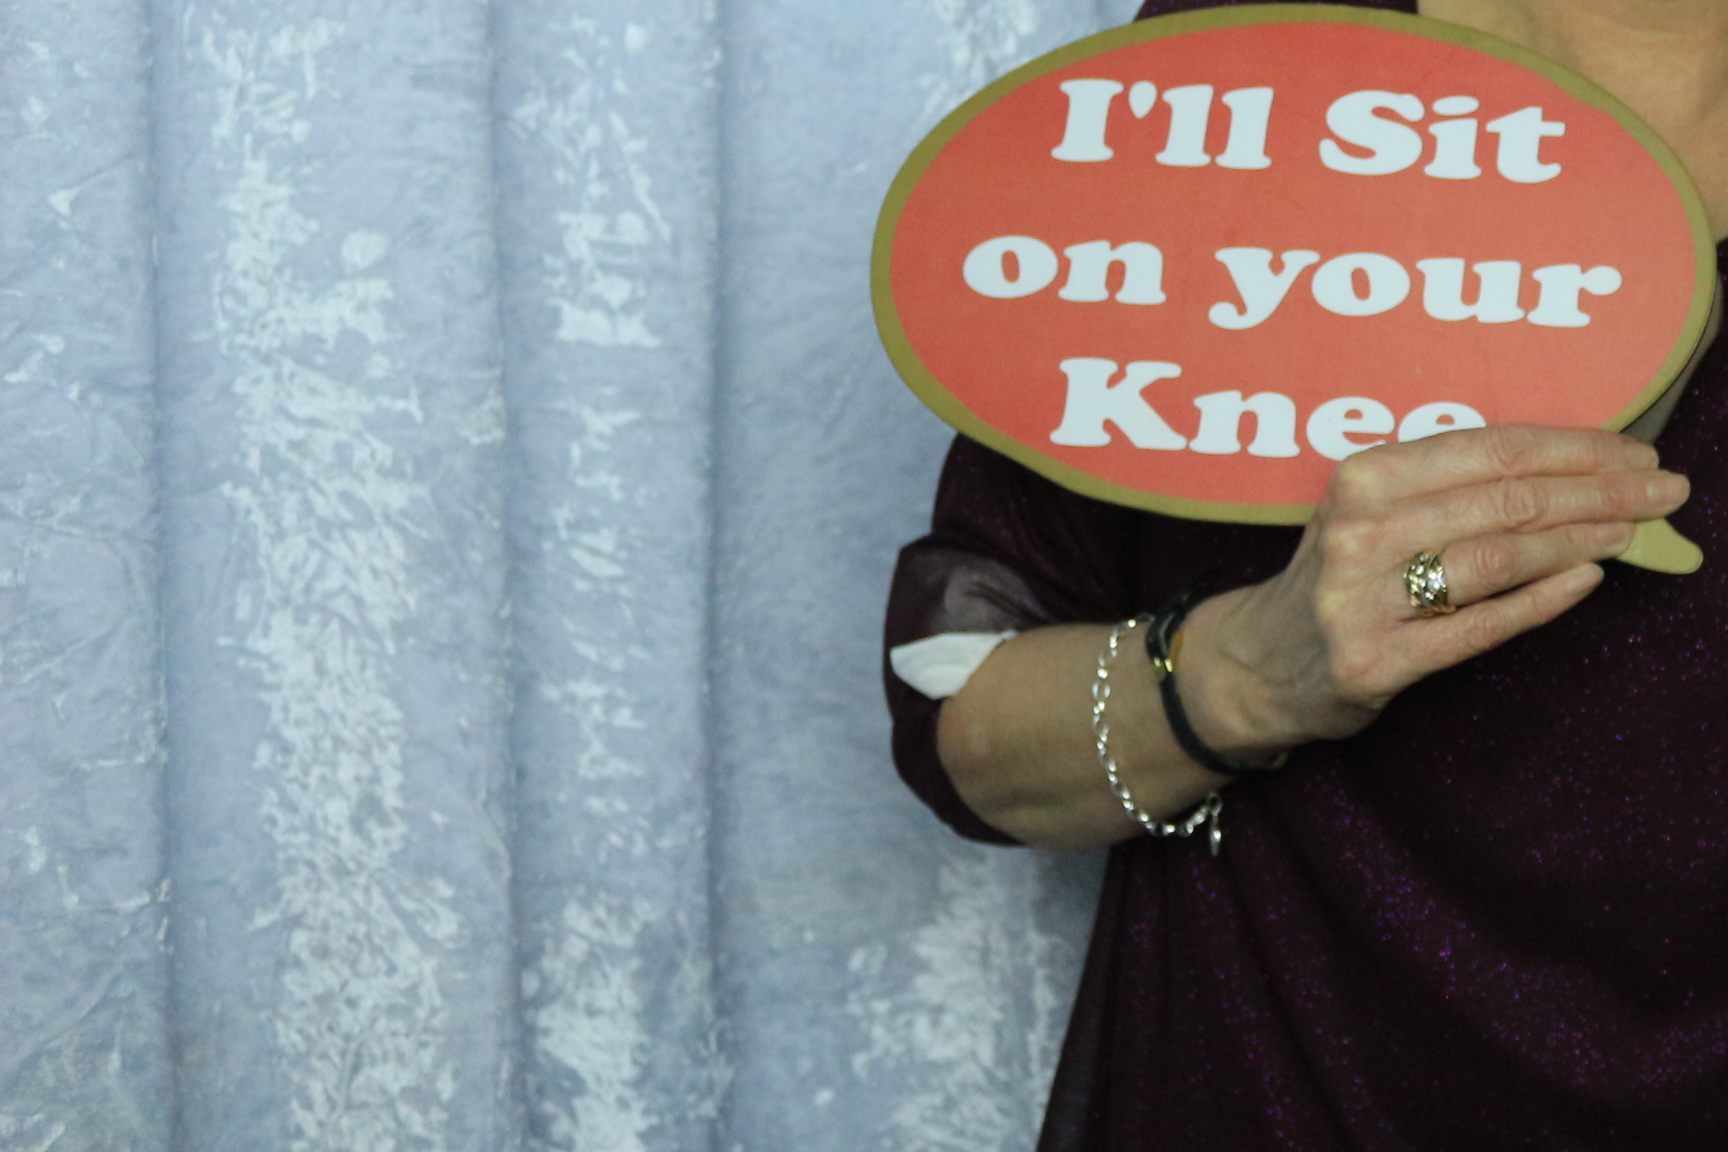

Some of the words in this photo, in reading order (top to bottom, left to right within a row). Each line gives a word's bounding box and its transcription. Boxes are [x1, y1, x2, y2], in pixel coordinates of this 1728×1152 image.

[1050, 78, 1275, 171] I'll
[1318, 89, 1567, 184] Sit
[961, 234, 1168, 306] on
[1207, 245, 1623, 331] your
